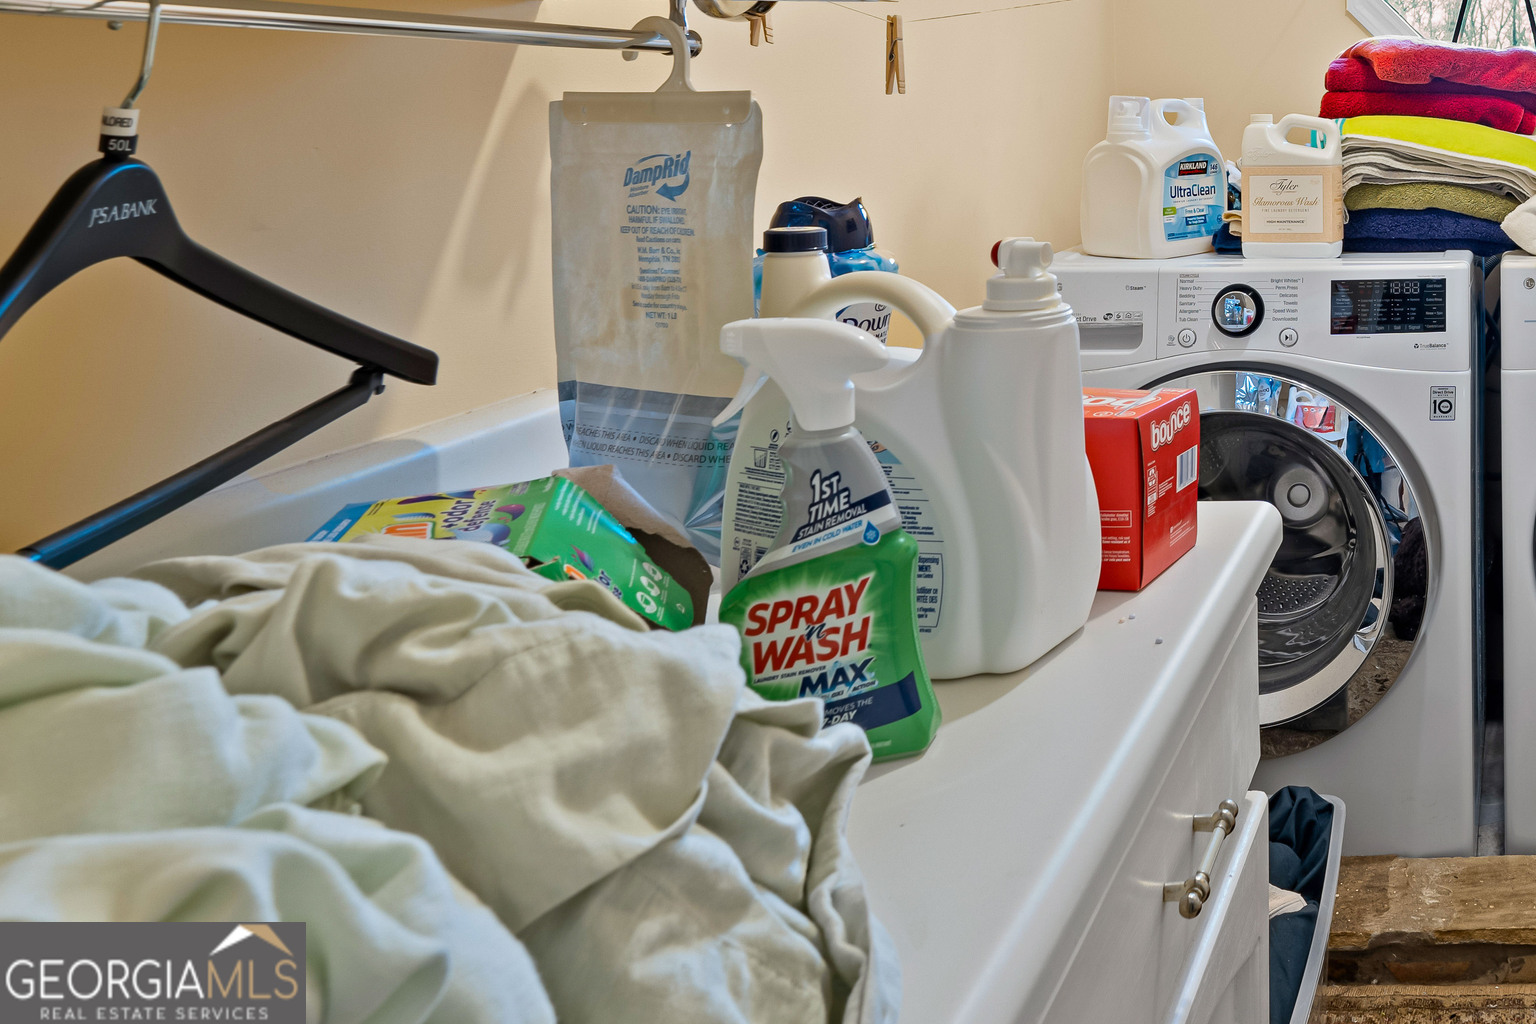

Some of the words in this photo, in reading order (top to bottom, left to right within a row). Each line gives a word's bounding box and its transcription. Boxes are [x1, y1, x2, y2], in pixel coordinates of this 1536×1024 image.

[108, 139, 132, 151] 50L
[623, 150, 691, 187] DampRid
[1180, 162, 1207, 170] KIRKLAND
[1170, 184, 1216, 198] UltraClean
[1269, 178, 1299, 196] Tyler
[626, 205, 660, 214] CAUTION:
[1252, 197, 1293, 206] Glamorous
[1296, 197, 1319, 206] Wash
[628, 216, 652, 224] HARMFUL
[632, 226, 640, 234] OUT
[650, 227, 668, 235] REACH
[843, 313, 891, 332] Down
[1082, 314, 1097, 322] Drive
[1432, 398, 1453, 414] 10
[1151, 400, 1191, 452] bounce
[602, 429, 616, 441] THIS
[638, 434, 666, 448] DISCAD
[666, 438, 688, 450] WHEN
[687, 441, 715, 451] LIQUID
[587, 442, 607, 453] LIQUID
[608, 444, 635, 457] REACHES
[636, 448, 650, 458] THIS
[672, 452, 706, 464] DISCARD
[708, 454, 732, 464] WHE
[811, 472, 840, 503] 1ST
[457, 500, 497, 532] defense
[809, 490, 850, 524] TIME
[797, 520, 824, 540] STAIN
[824, 503, 868, 528] REMOVAL
[792, 540, 813, 553] EVEN
[813, 536, 822, 545] IN
[822, 529, 841, 542] COLD
[841, 520, 863, 534] WATER
[744, 576, 871, 637] SPRAY
[753, 616, 871, 675] WASH
[753, 674, 780, 684] LAUNDRY
[798, 665, 827, 676] REMOVER
[799, 656, 876, 697] MAX
[831, 690, 844, 698] OXI
[852, 680, 877, 692] ACTION
[824, 702, 856, 715] MOVES
[856, 696, 874, 708] THE
